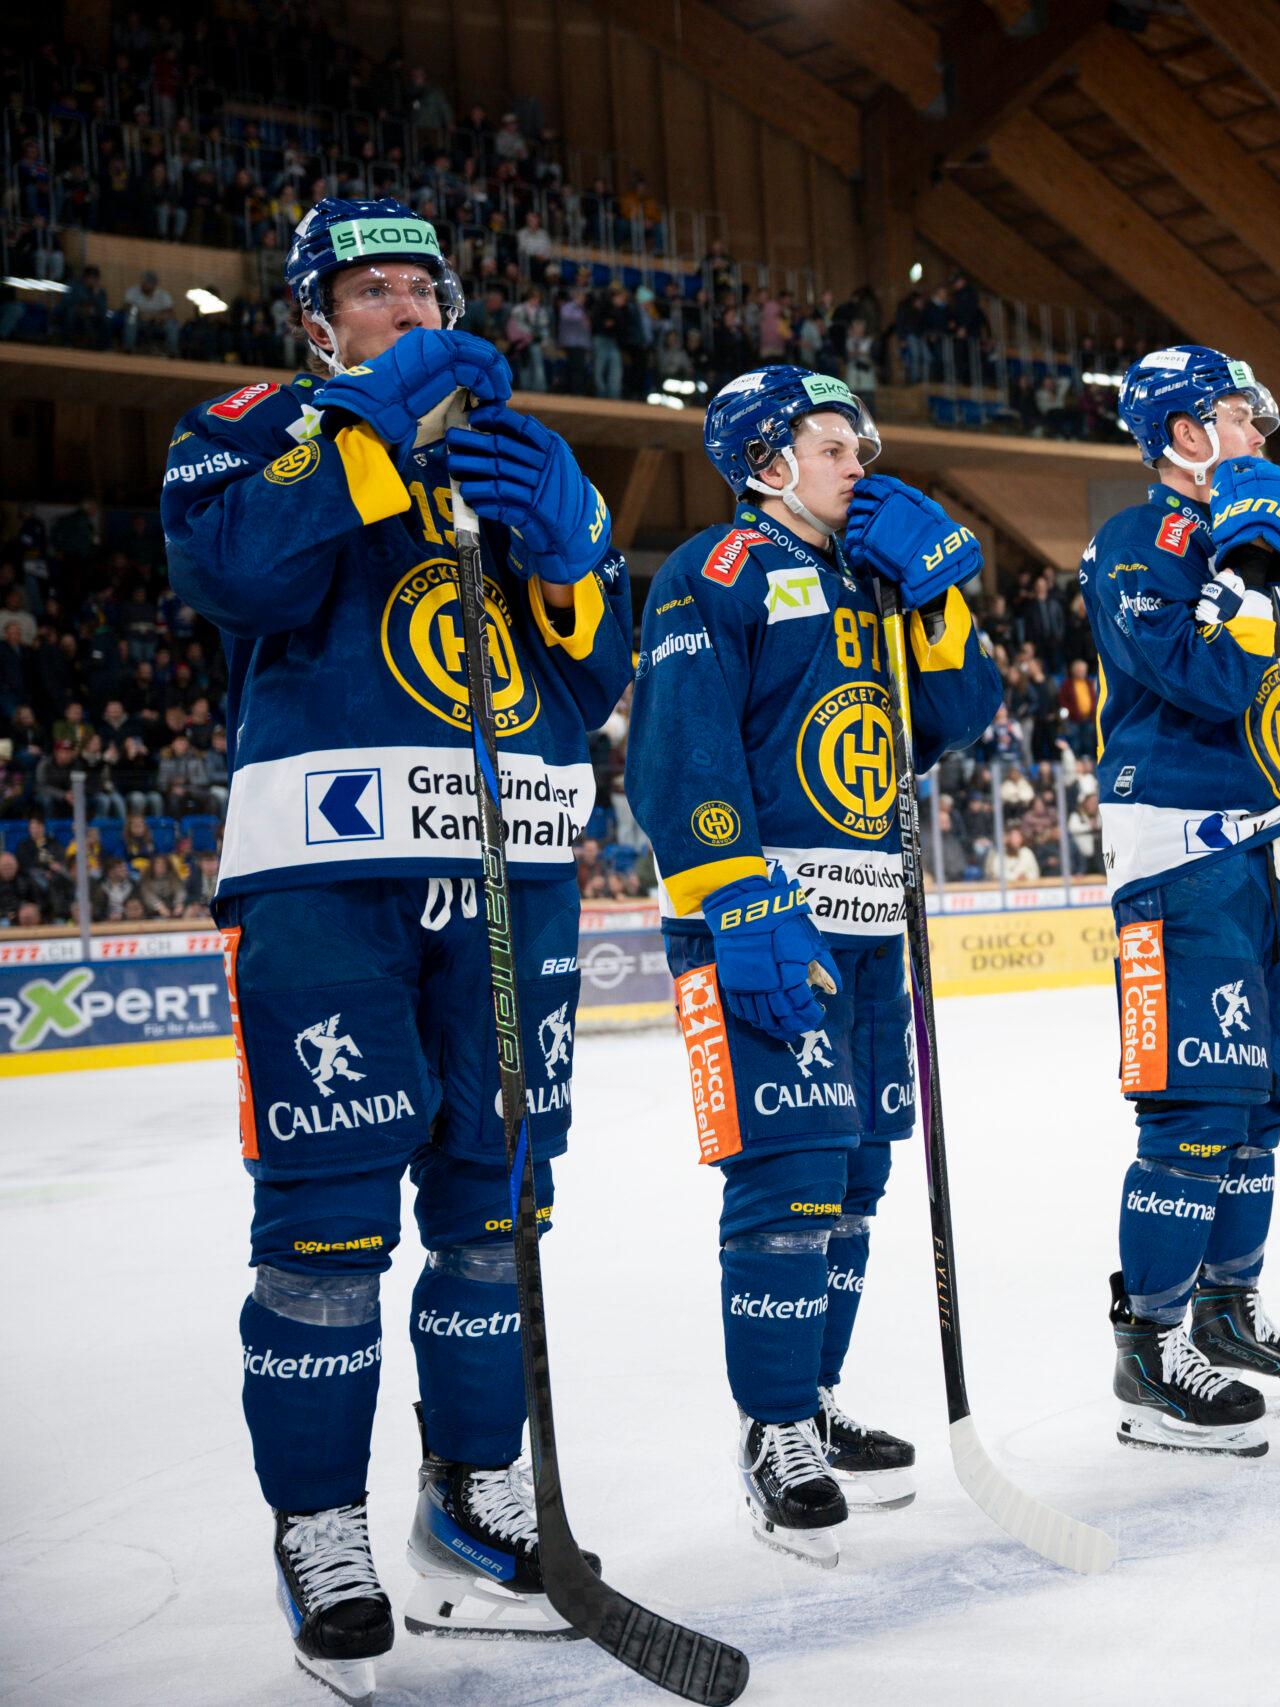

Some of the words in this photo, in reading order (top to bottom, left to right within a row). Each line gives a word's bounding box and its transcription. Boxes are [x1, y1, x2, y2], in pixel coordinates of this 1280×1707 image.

[398, 564, 461, 606] HOCKE
[651, 627, 714, 666] radiogri
[834, 607, 881, 672] 87
[452, 702, 520, 728] DOS
[814, 688, 876, 727] HOCKEY
[843, 812, 889, 833] DAVOS
[1123, 985, 1142, 1086] Castelli
[1141, 982, 1163, 1050] Luca
[687, 1043, 720, 1157] Castelli
[703, 1034, 726, 1113] Luca
[268, 1089, 416, 1141] CALANDA
[933, 1235, 951, 1332] FLYLITE
